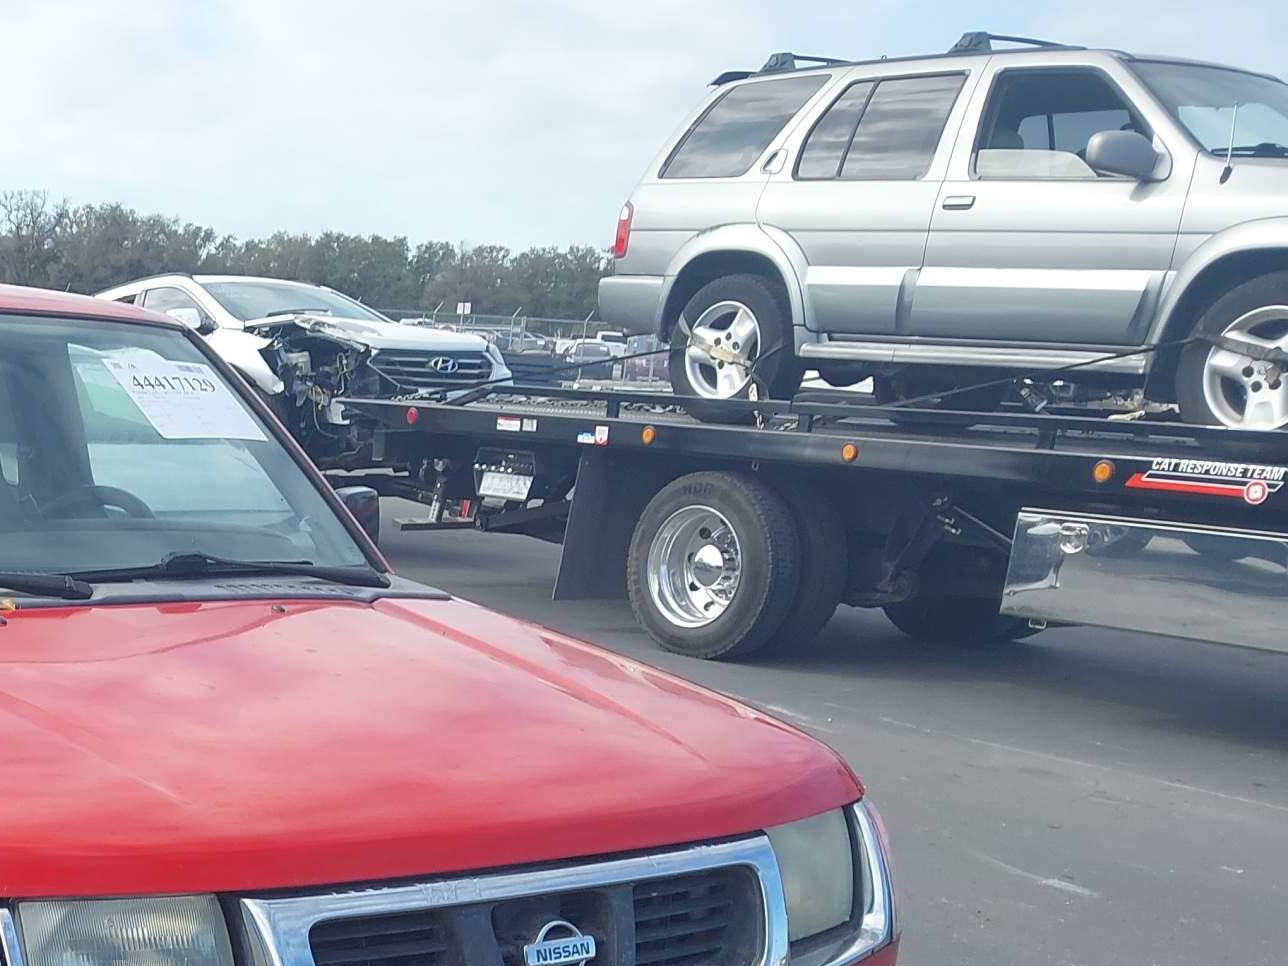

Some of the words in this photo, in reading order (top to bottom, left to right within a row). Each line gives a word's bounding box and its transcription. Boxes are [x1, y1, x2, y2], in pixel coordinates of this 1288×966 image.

[131, 374, 216, 393] 44417129
[1151, 457, 1176, 471] CAT
[1178, 458, 1245, 477] RESPONSE
[1246, 464, 1286, 481] TEAM
[535, 941, 590, 963] NISSAN
